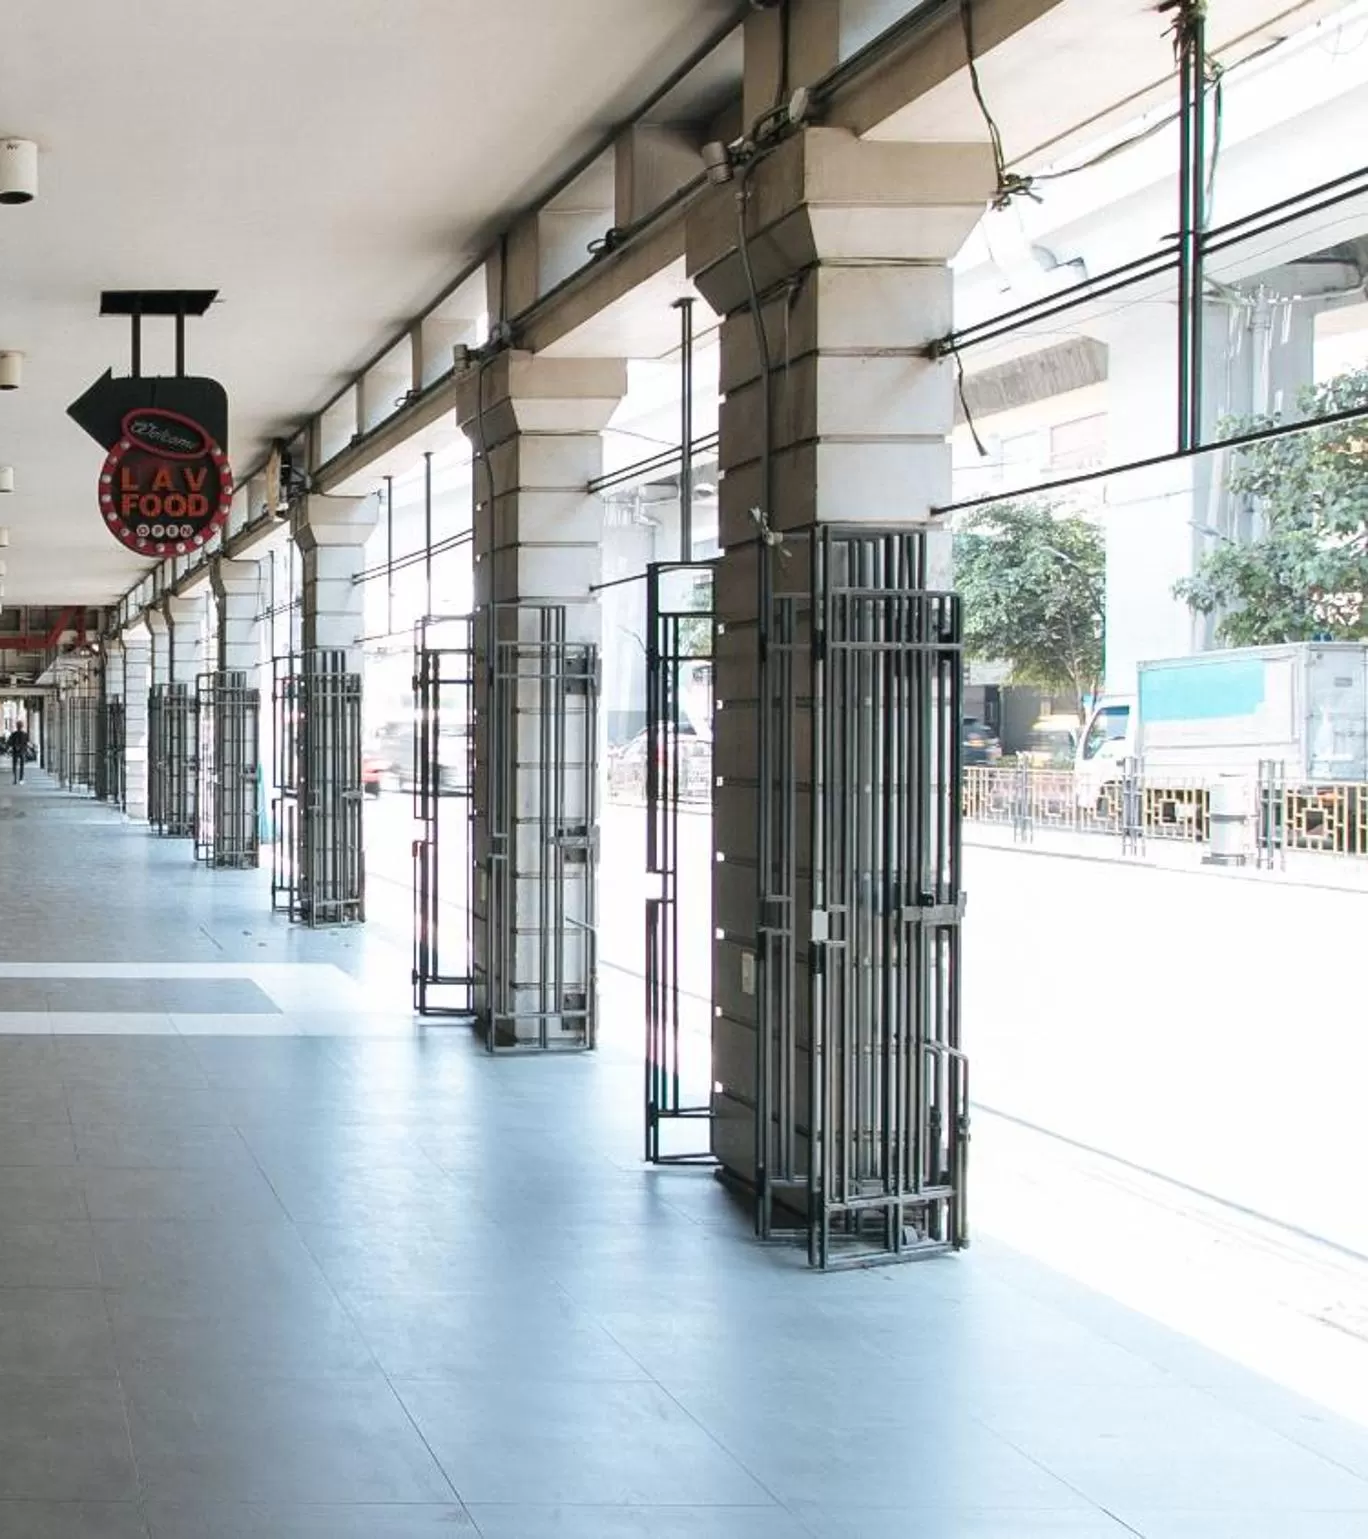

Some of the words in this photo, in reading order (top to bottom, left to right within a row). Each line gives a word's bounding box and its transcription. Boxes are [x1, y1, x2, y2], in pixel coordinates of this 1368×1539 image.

[121, 466, 208, 491] LAV
[121, 493, 209, 517] FOOD
[137, 525, 193, 537] OPEN
